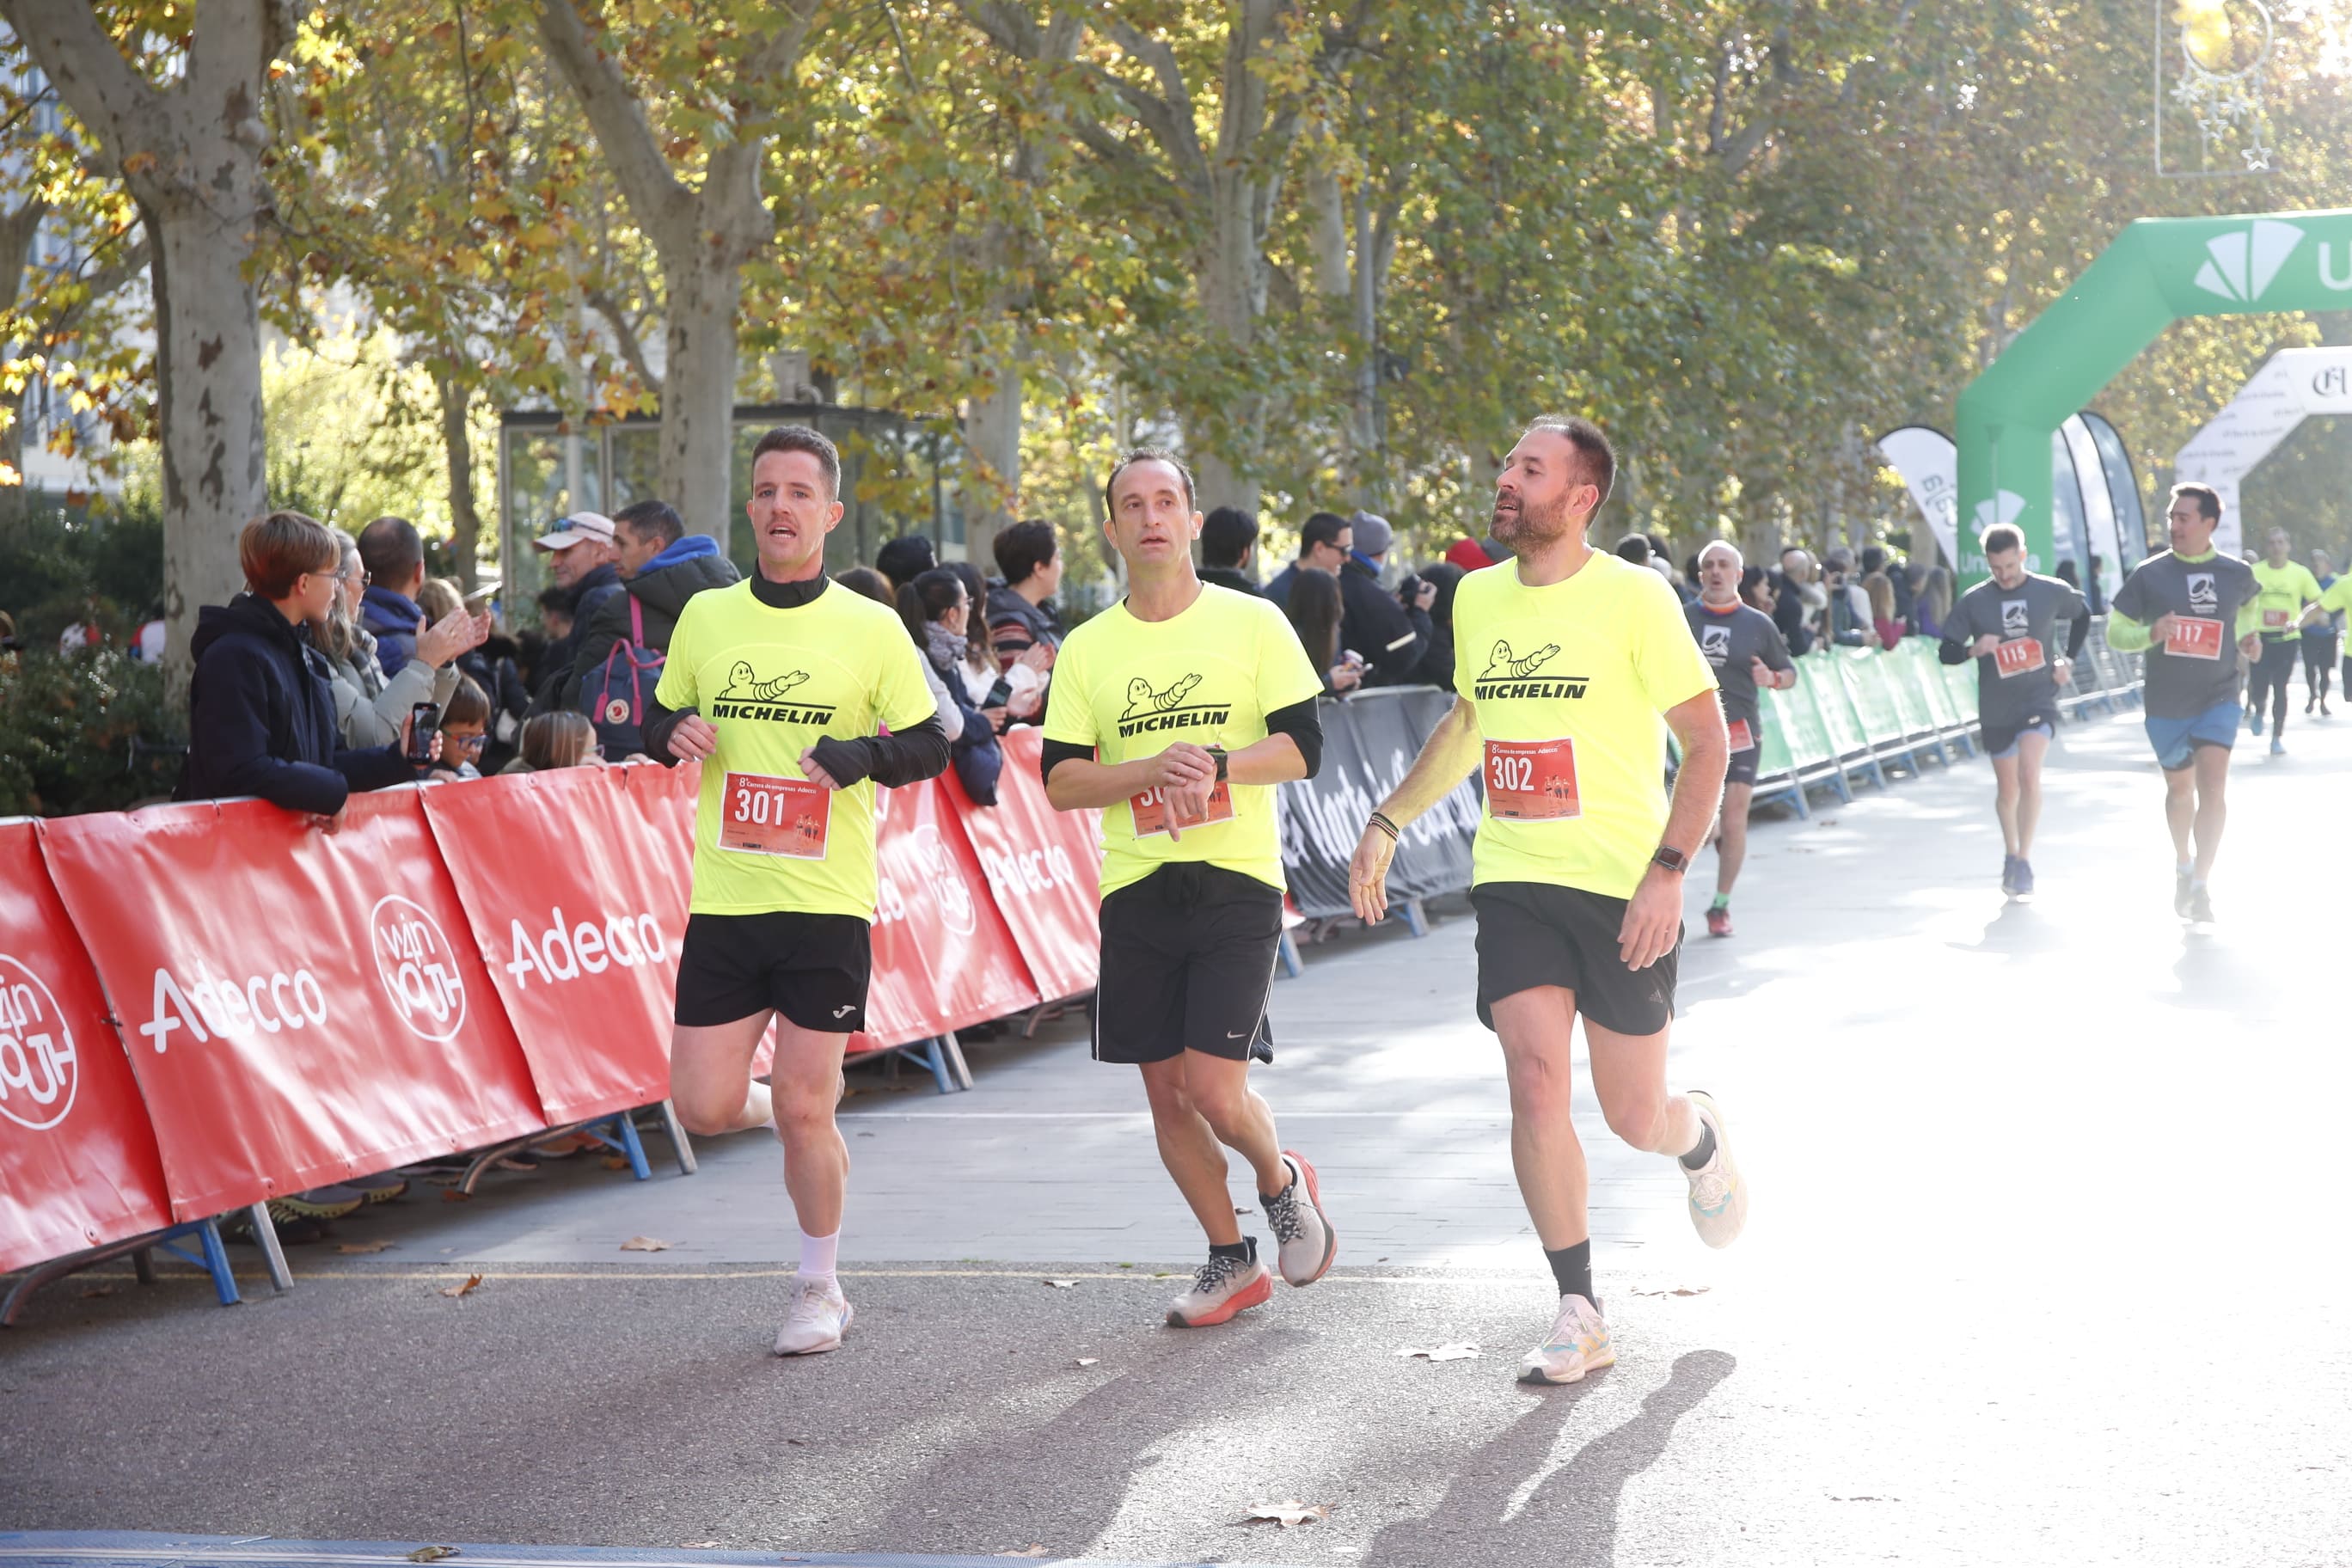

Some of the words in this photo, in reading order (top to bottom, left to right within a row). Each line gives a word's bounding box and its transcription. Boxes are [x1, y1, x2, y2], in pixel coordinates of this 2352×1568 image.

[2176, 624, 2202, 643] 117
[2001, 645, 2028, 665] 115
[1474, 683, 1587, 701] MICHELIN
[713, 704, 833, 726] MICHELIN
[1118, 711, 1229, 738] MICHELIN
[1538, 746, 1559, 755] Adecco
[1491, 756, 1534, 791] 302
[735, 788, 785, 826] 301
[505, 906, 666, 989] Adecco
[139, 958, 327, 1054] Adecco
